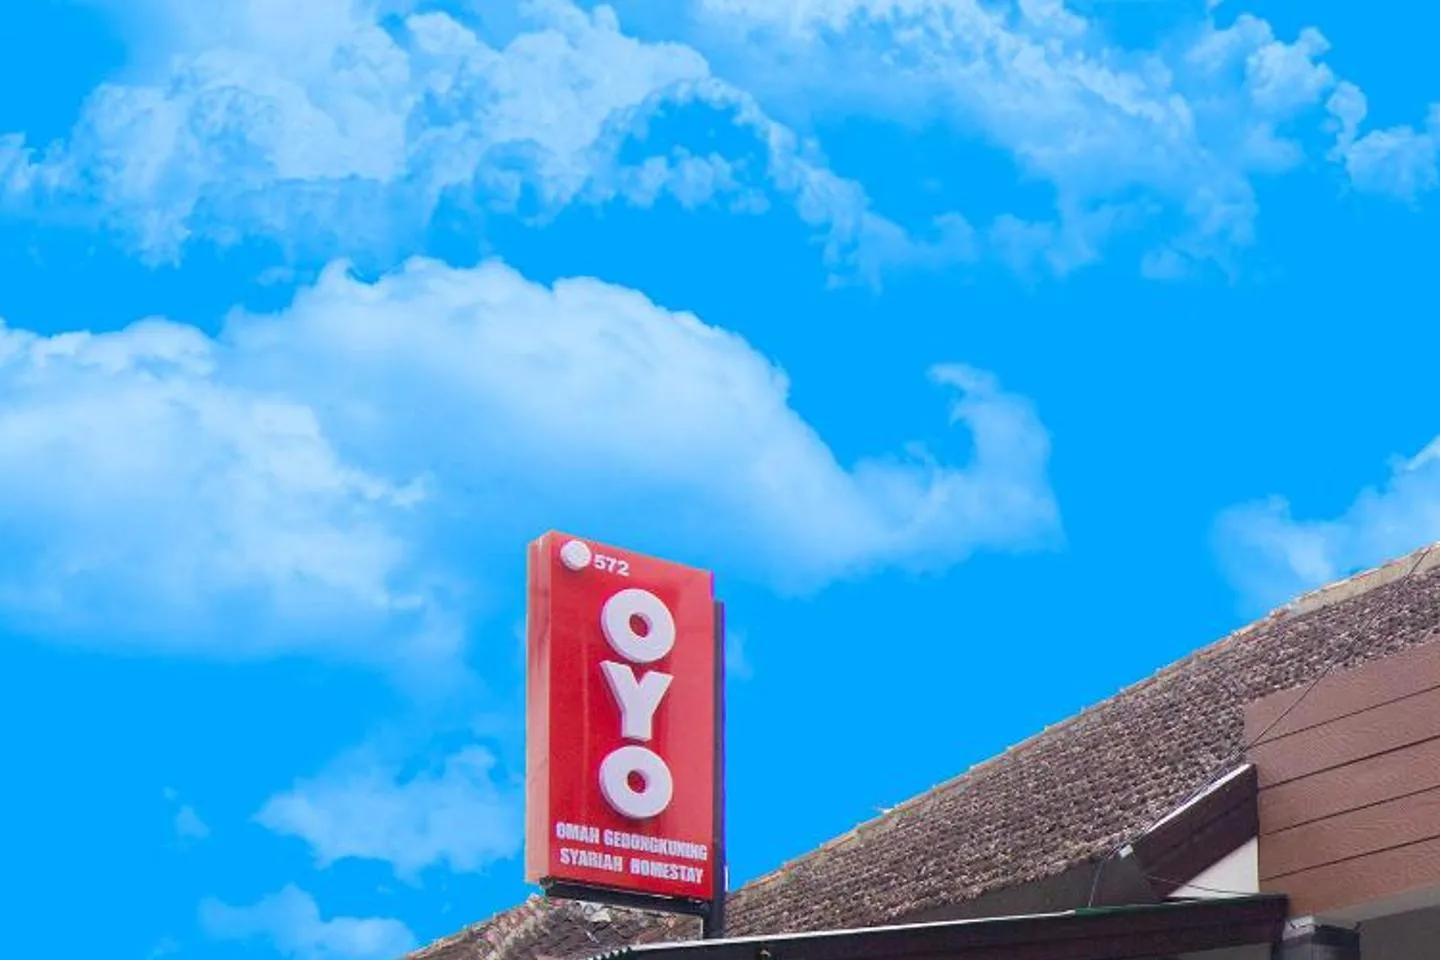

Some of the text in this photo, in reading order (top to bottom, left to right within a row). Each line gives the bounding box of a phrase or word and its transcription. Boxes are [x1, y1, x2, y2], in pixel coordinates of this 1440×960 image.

[594, 554, 630, 576] 572
[556, 822, 708, 861] OMAH GEDONGKUNING
[560, 848, 704, 884] SYARIAH HOMESTAY
